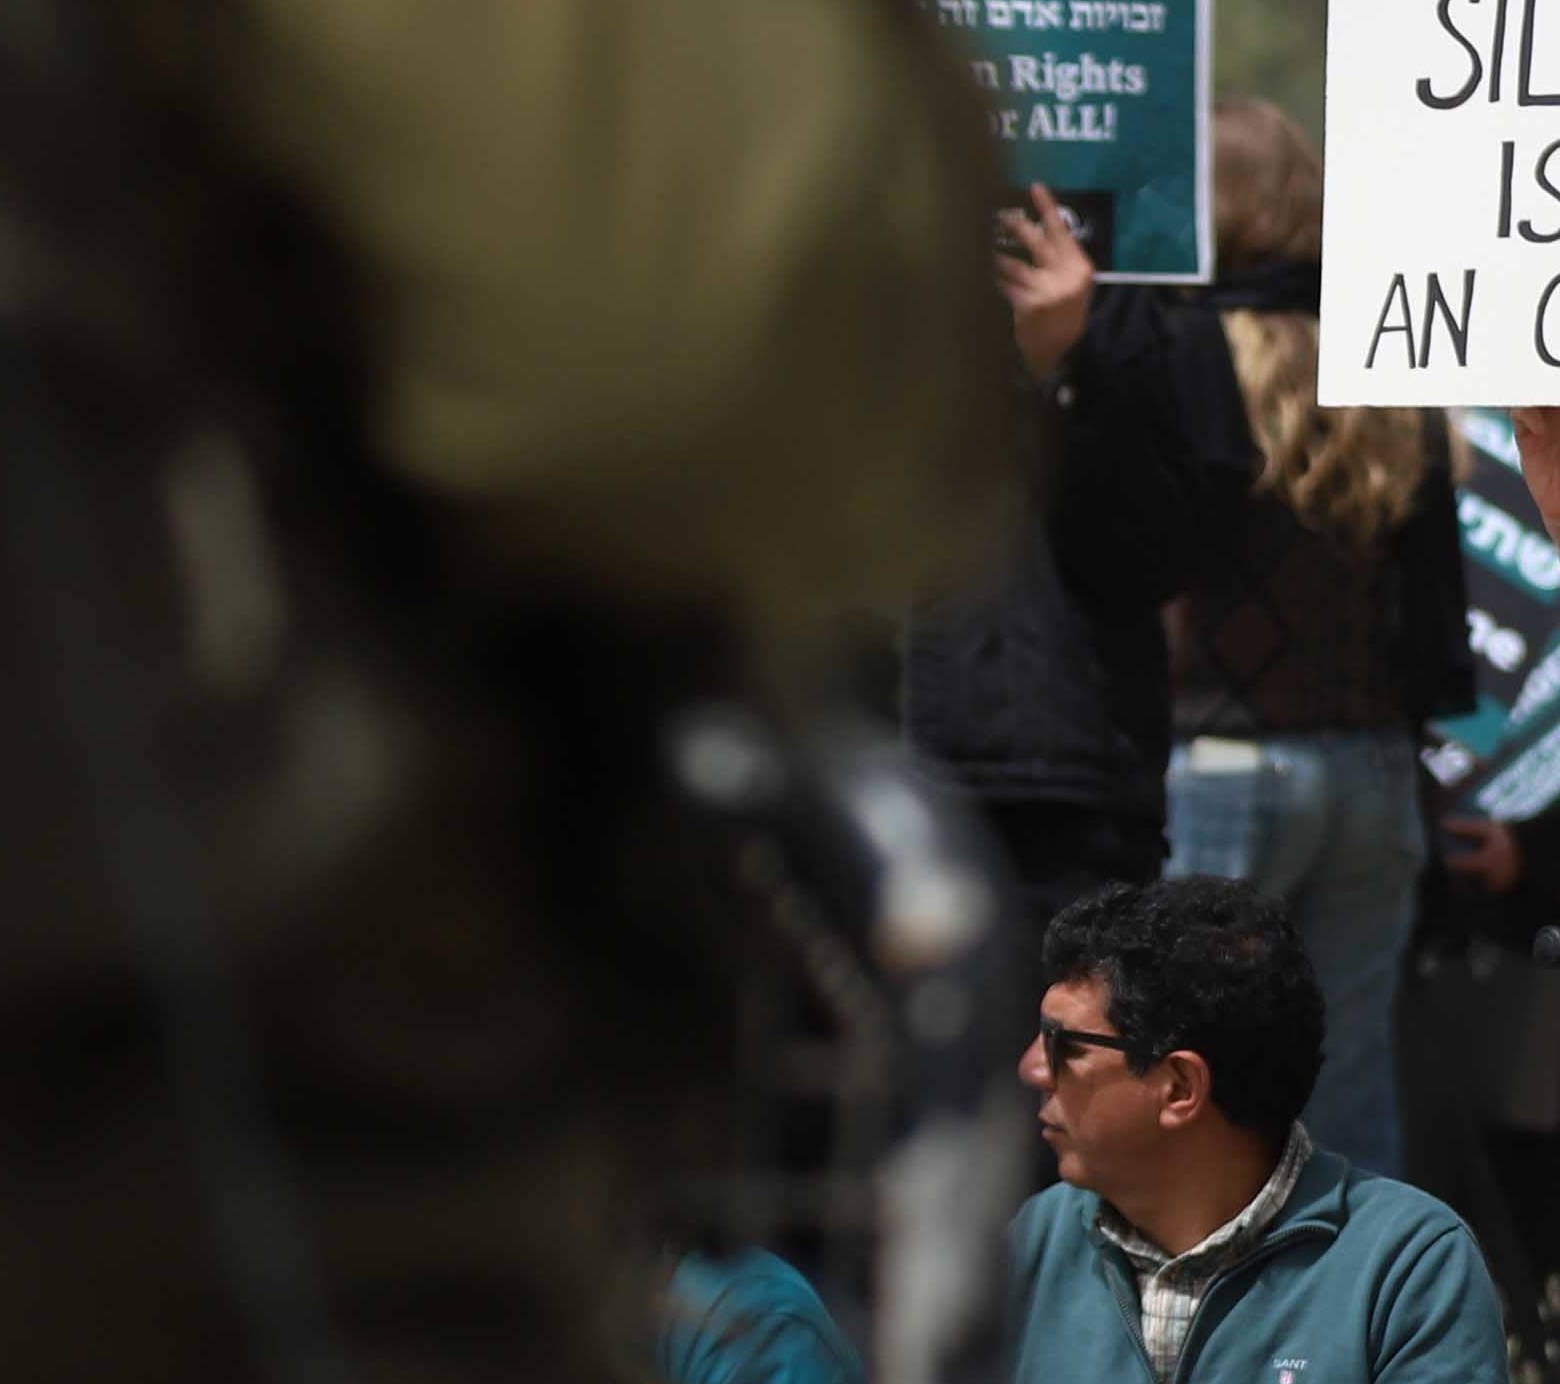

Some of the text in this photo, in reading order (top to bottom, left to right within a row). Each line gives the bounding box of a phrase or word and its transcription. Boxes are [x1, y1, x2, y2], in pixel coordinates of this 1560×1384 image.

[1009, 52, 1147, 101] Rights
[1028, 103, 1117, 142] ALL!
[1365, 268, 1476, 370] AN
